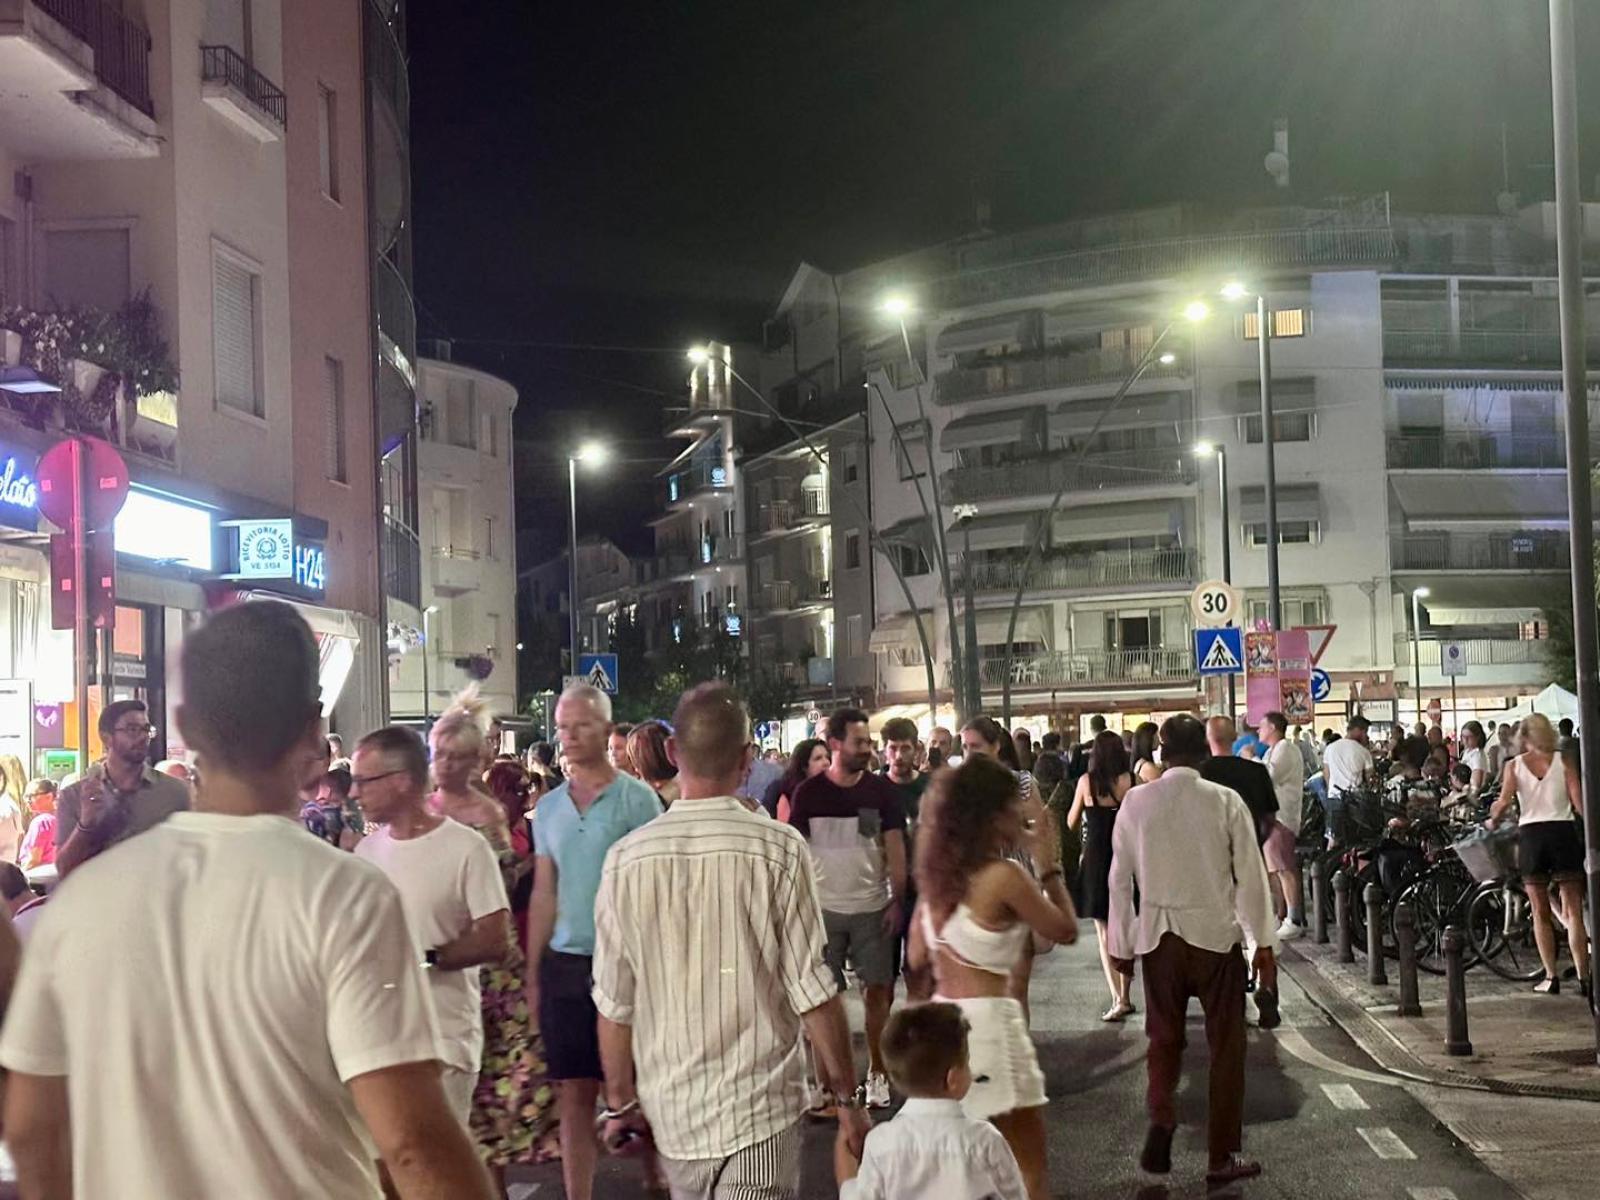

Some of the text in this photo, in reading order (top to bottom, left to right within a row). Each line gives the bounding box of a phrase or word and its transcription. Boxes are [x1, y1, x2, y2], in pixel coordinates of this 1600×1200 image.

[242, 527, 290, 561] RICEVITORIA LOTTO
[295, 544, 325, 590] H24
[1202, 592, 1228, 613] 30
